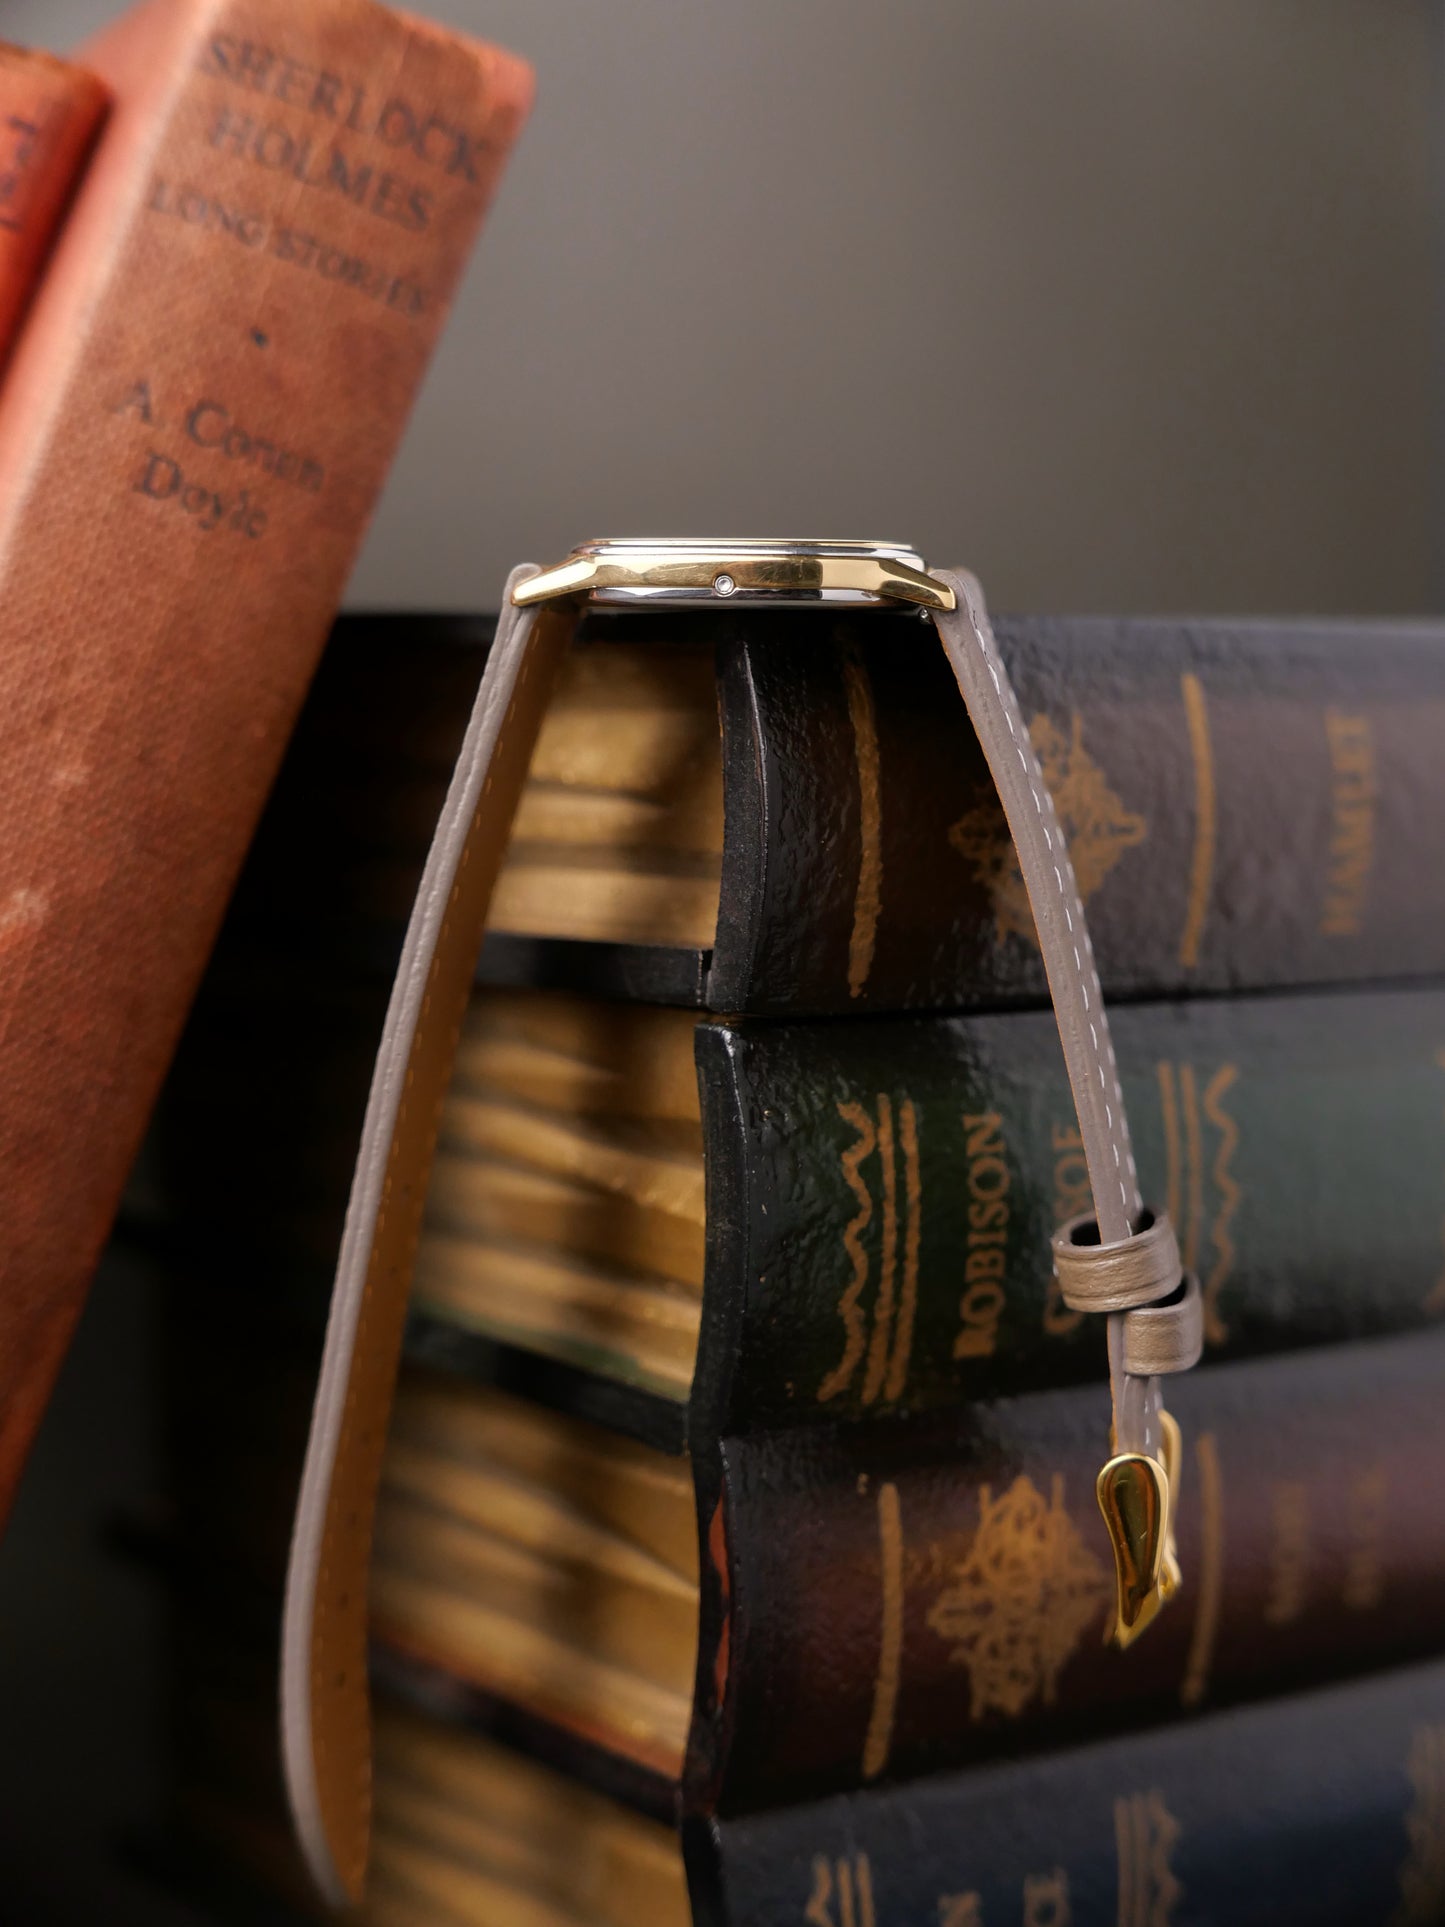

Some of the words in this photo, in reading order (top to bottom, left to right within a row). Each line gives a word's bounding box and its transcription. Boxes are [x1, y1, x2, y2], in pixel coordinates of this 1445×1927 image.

[204, 35, 488, 182] SHERLOCK
[148, 178, 264, 248] LONG
[208, 106, 433, 231] HOLMES
[134, 451, 268, 540] Doyle
